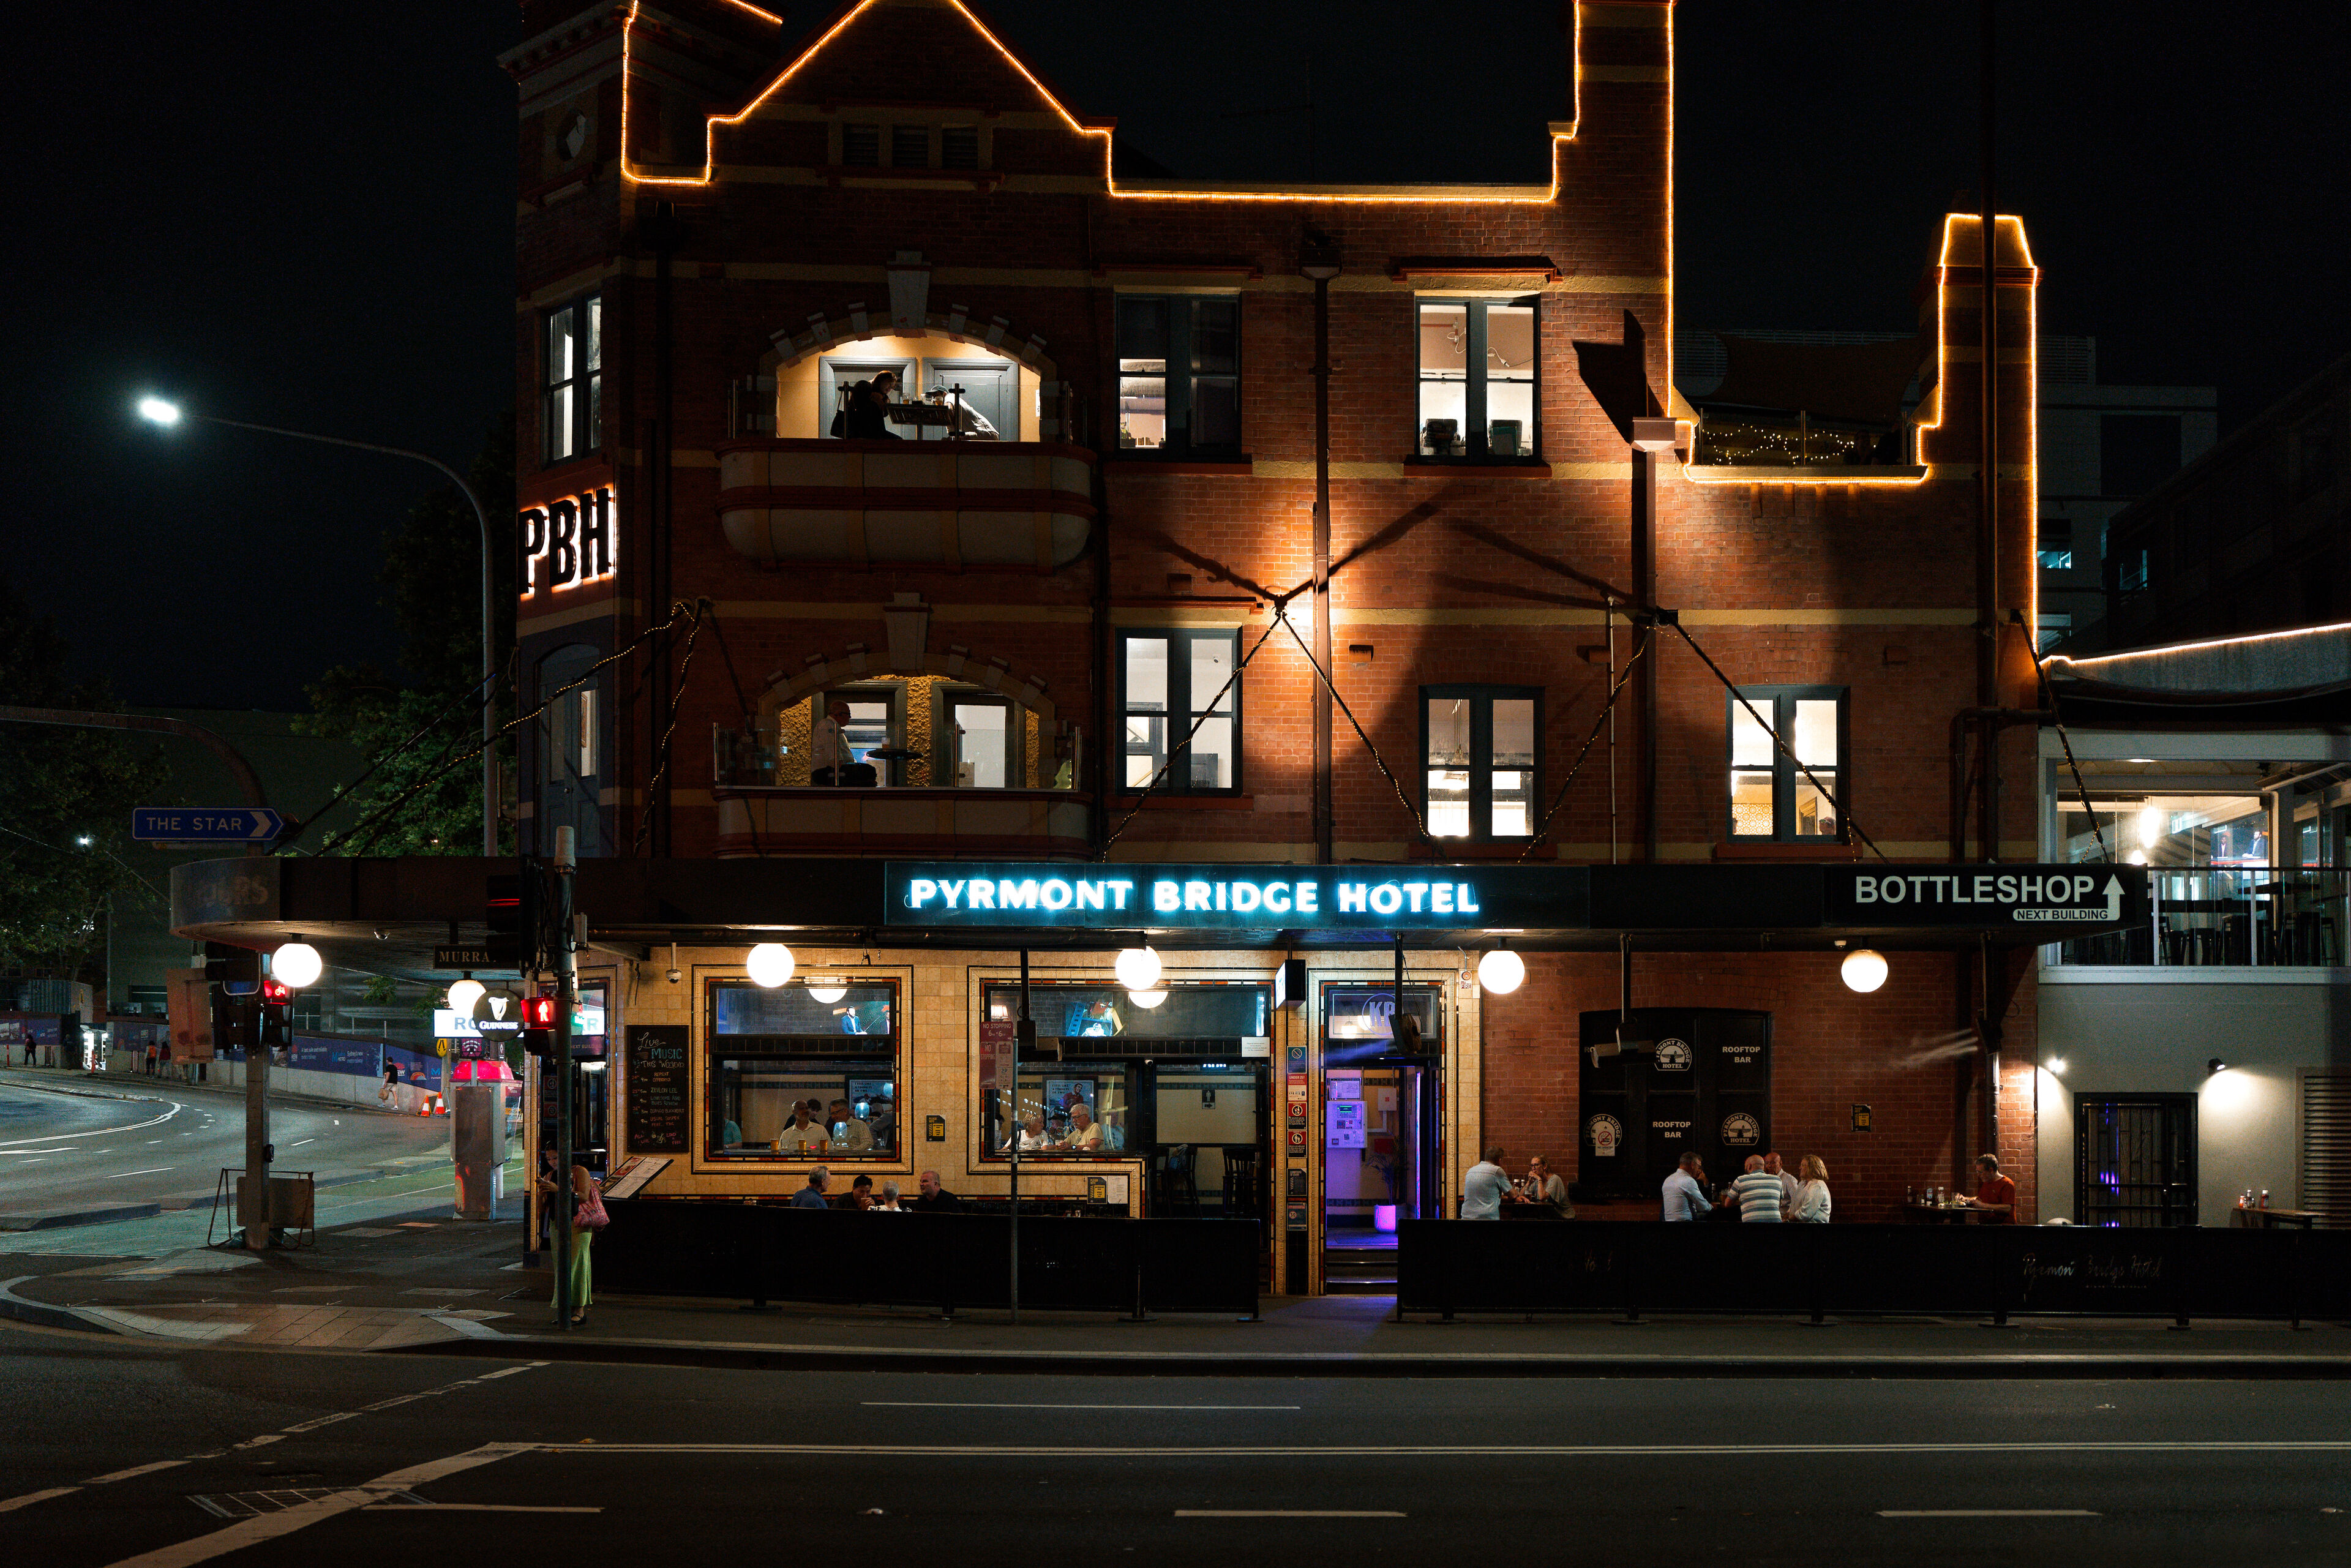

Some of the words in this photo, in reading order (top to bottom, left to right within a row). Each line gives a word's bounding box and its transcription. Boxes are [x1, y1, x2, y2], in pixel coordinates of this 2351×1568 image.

[518, 488, 609, 593] PBH
[146, 817, 181, 830] THE
[193, 817, 241, 831] STAR
[910, 879, 1132, 909] PYRMONT
[1153, 881, 1318, 912] BRIDGE
[1340, 882, 1479, 913] HOTEL
[1856, 875, 2094, 904] BOTTLESHOP
[2017, 910, 2048, 920] NEXT
[2052, 910, 2108, 920] BUILDING
[439, 951, 497, 962] MURRA
[479, 1021, 519, 1030] GUINNESS
[651, 1048, 682, 1059] MUSIC
[1676, 1041, 1691, 1063] BRIDGE
[1607, 1117, 1621, 1139] BRIDGE
[1723, 1115, 1743, 1137] PYRMONT
[1744, 1116, 1758, 1137] BRIDGE
